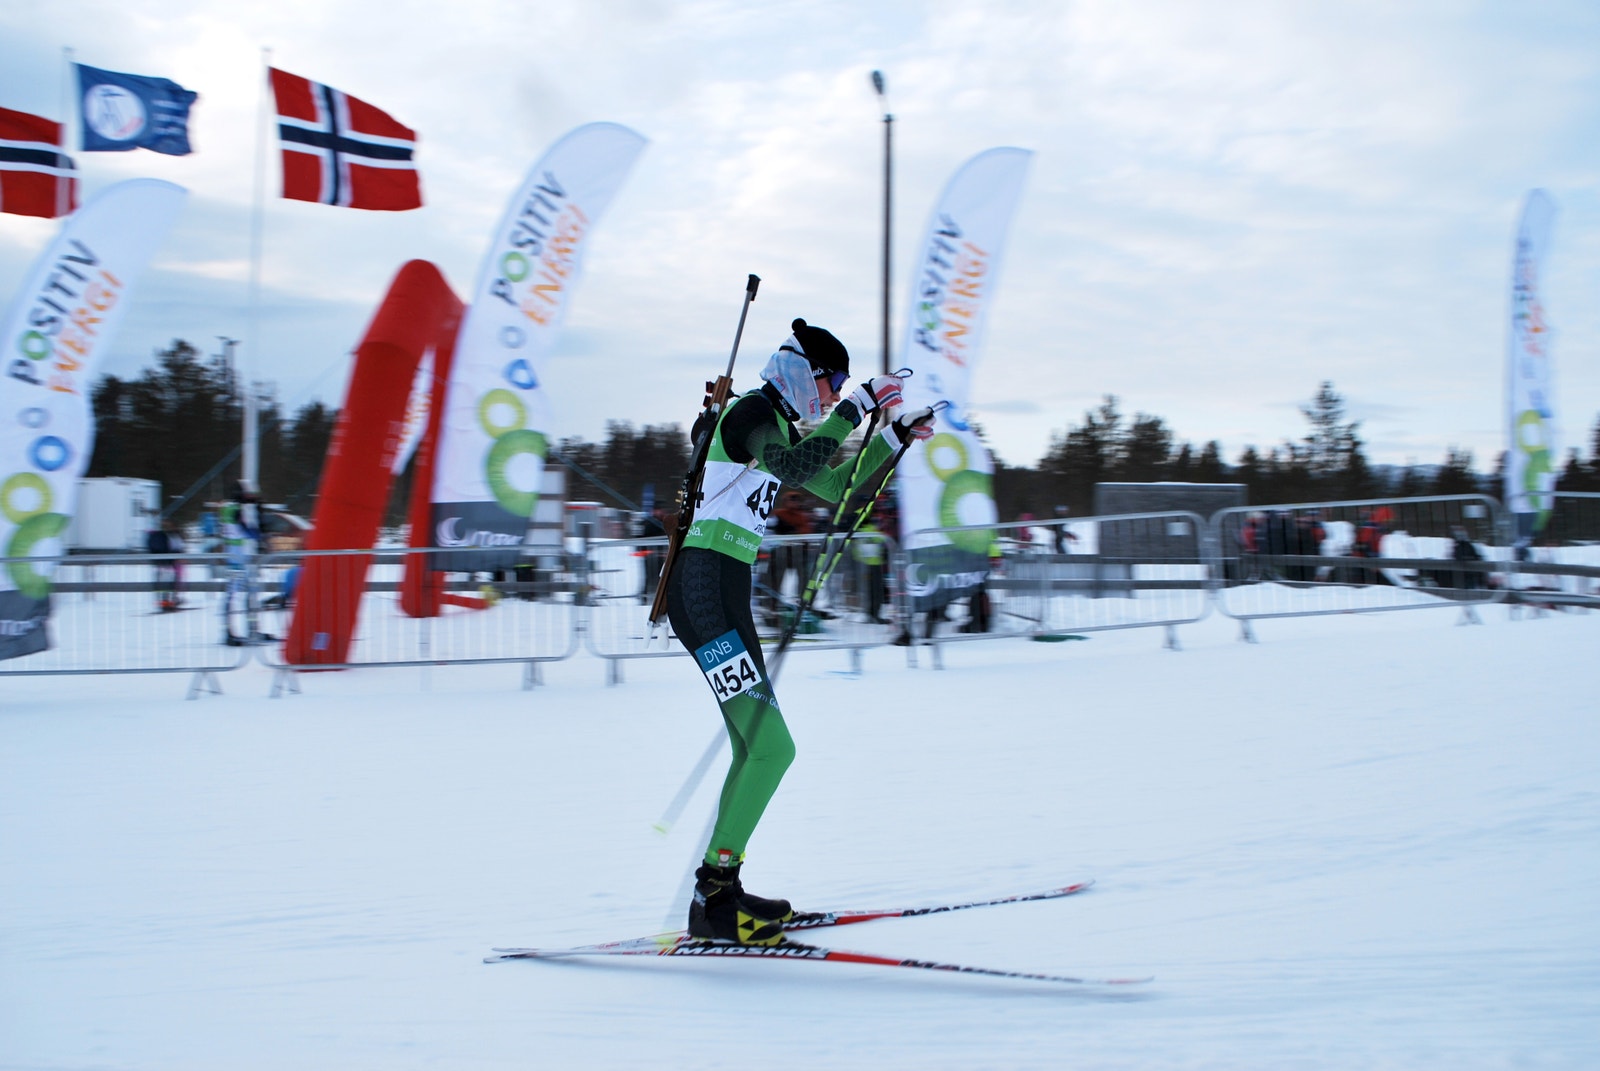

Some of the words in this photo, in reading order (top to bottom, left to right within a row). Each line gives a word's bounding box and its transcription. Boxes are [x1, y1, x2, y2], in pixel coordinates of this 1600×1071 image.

[488, 170, 568, 308] POSITIV
[519, 203, 590, 327] ENERGI
[913, 213, 964, 353] POSITIV
[5, 238, 102, 386] POSITIV
[47, 269, 125, 396] ENERGI
[778, 398, 793, 418] Swix
[722, 530, 734, 542] En
[703, 640, 733, 664] DNB
[712, 657, 757, 698] 454
[744, 687, 768, 703] Team
[674, 946, 831, 960] MADSHUS
